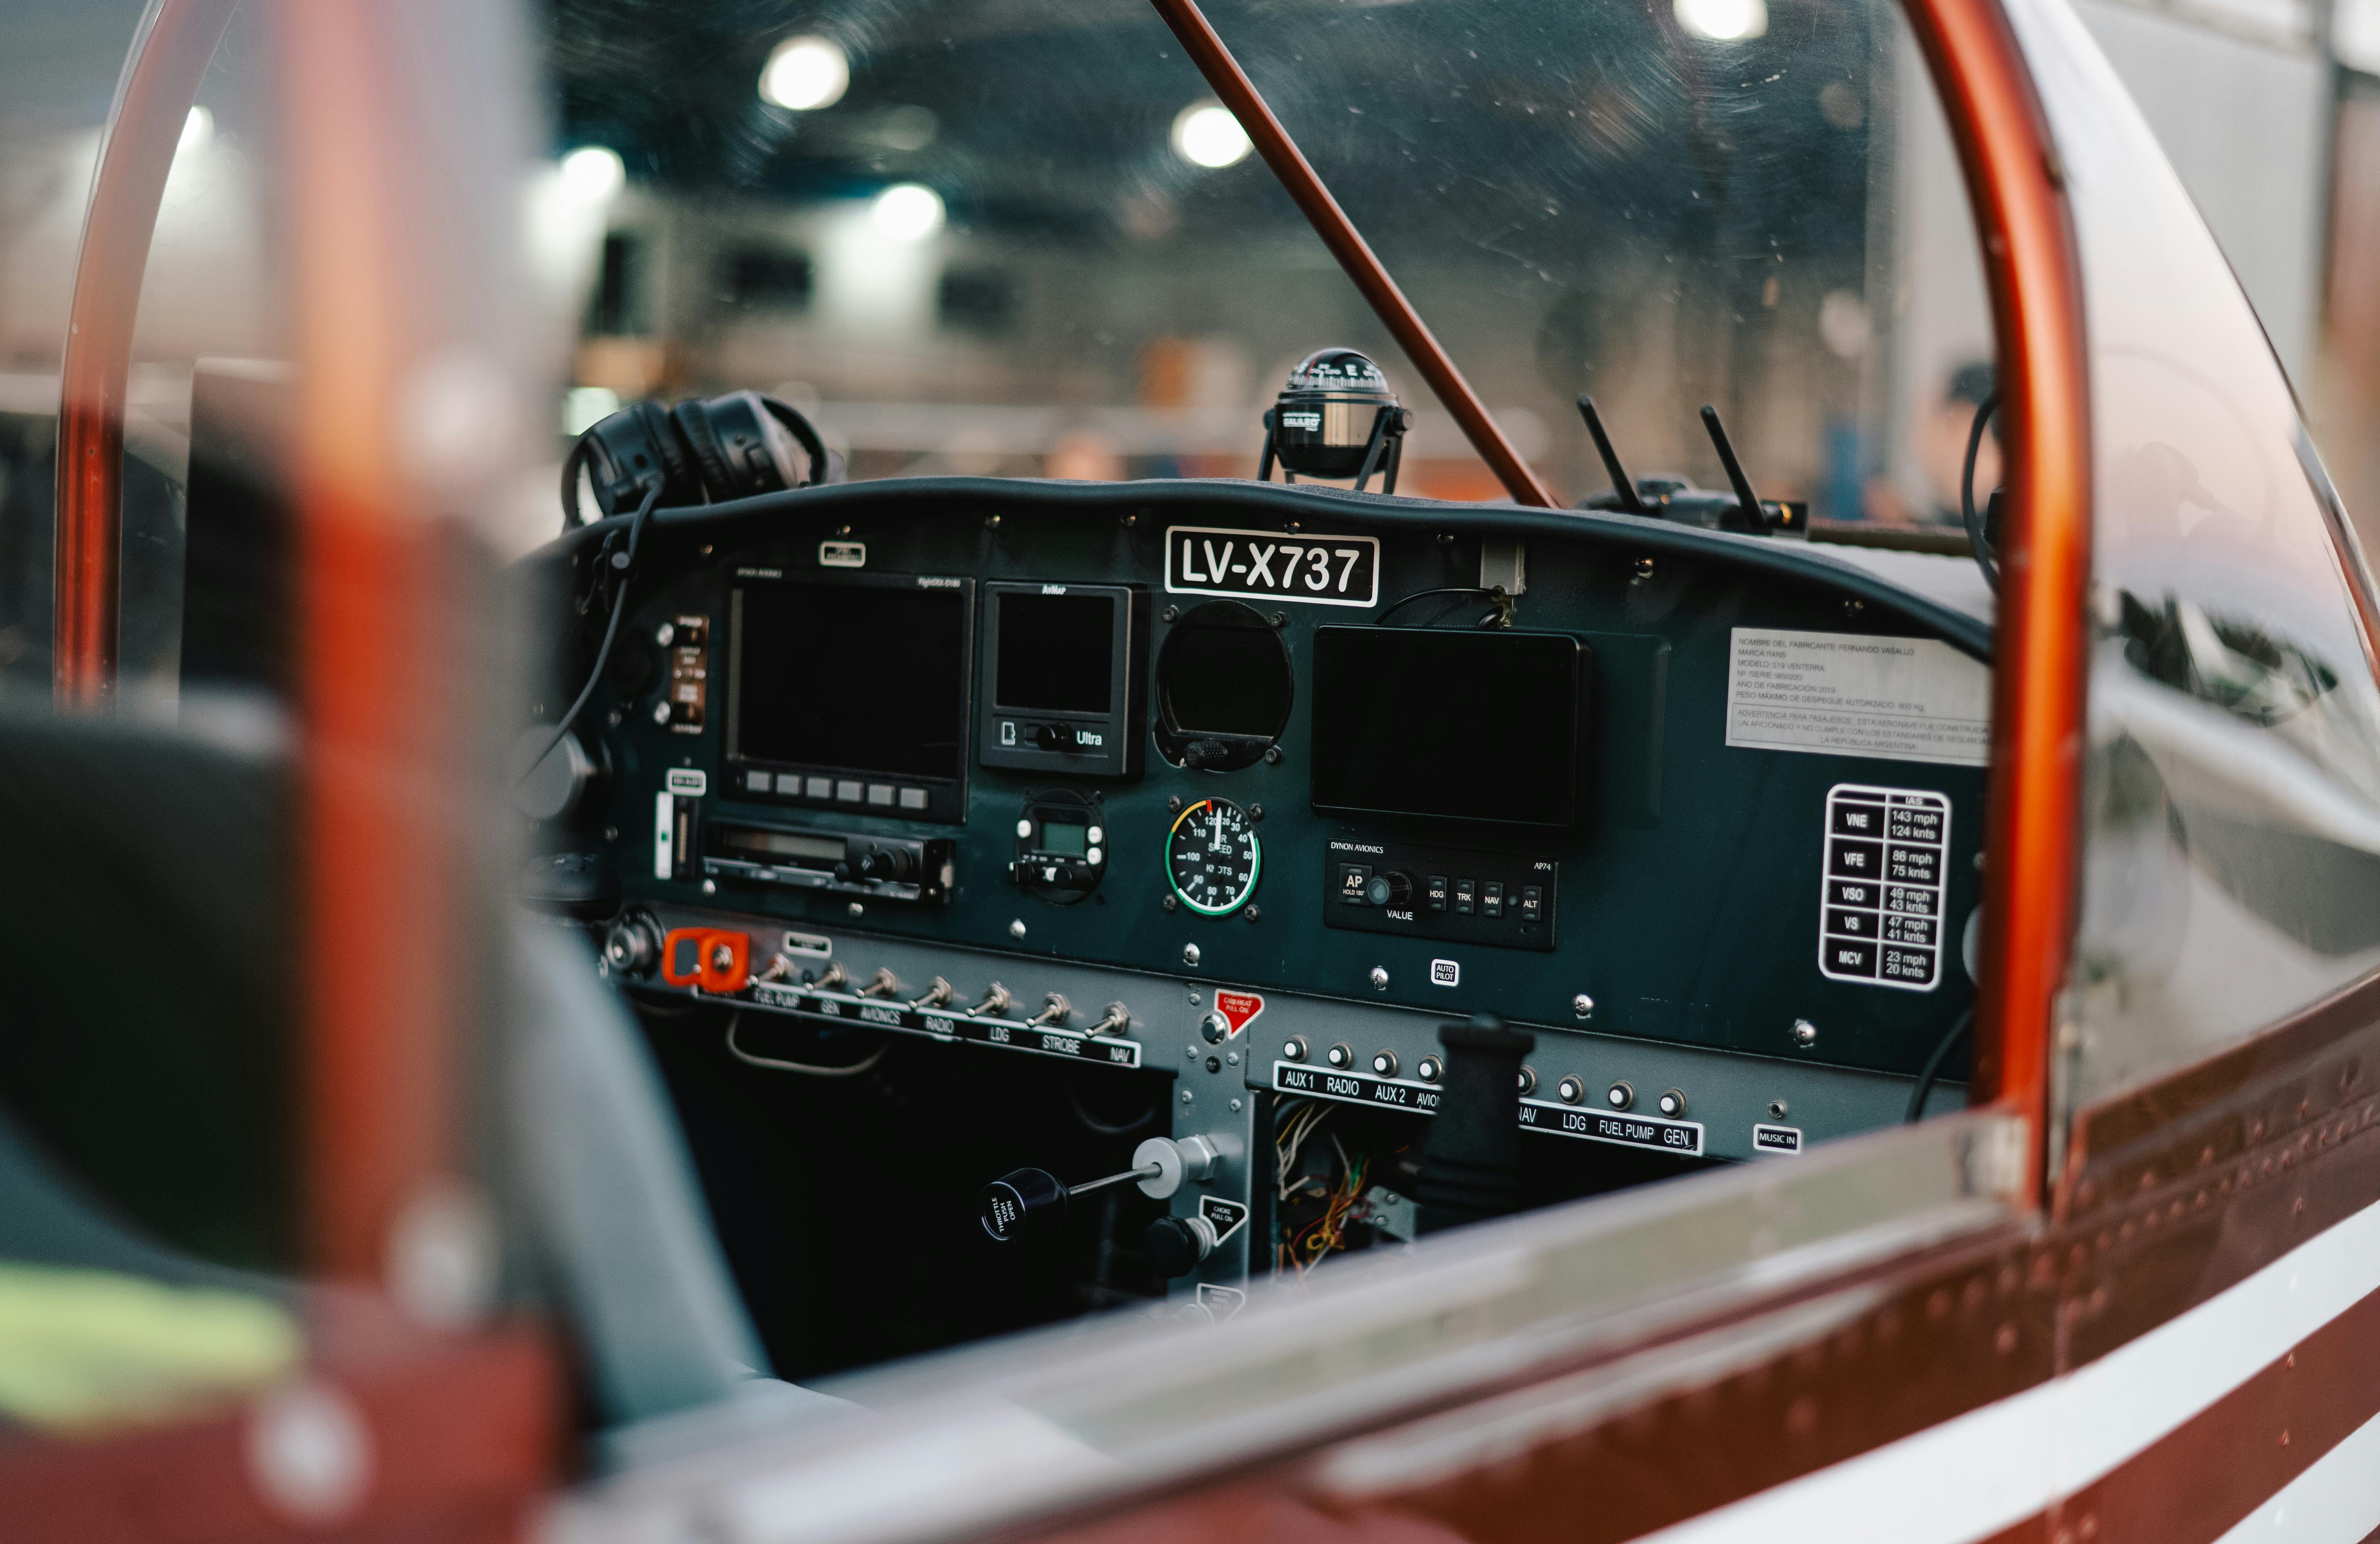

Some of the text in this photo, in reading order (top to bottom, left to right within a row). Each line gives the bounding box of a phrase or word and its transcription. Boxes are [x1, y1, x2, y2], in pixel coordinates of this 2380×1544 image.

[1345, 364, 1358, 376] E
[1183, 539, 1359, 592] LV-X737
[1739, 638, 1770, 647] NOMBRE
[1838, 644, 1879, 653] FERNANDO
[1881, 647, 1914, 655] VASALLO
[1787, 663, 1824, 671] VENTERRA
[1802, 696, 1843, 705] DESPEGUE
[1738, 710, 1786, 719] ADVERTENCIA
[1878, 720, 1918, 729] AERONAVE
[1750, 721, 1793, 730] AFICIONADO
[1076, 731, 1102, 746] Ultra
[1874, 740, 1915, 750] ARGENTINA
[1905, 796, 1923, 805] IAS
[1205, 816, 1217, 825] 120
[1846, 813, 1867, 827] VNE
[1892, 810, 1938, 826] 143 mph
[1193, 828, 1206, 837] 110
[1231, 823, 1240, 831] 30
[1891, 825, 1936, 839] 124 knts
[1238, 834, 1248, 843] 40
[1331, 842, 1383, 854] DYNON AVIONICS
[1186, 852, 1200, 861] 100
[1243, 851, 1252, 860] 50
[1844, 852, 1864, 867] VFE
[1893, 850, 1932, 866] 86 mph
[1534, 862, 1551, 871] AP74
[1892, 865, 1931, 879] 75 knts
[1194, 875, 1204, 884] 90
[1238, 873, 1248, 881] 60
[1346, 875, 1362, 887] AP
[1207, 886, 1217, 895] 80
[1225, 886, 1235, 895] 70
[1457, 893, 1471, 901] TRK
[1890, 887, 1930, 903] 49 mph
[1485, 896, 1499, 904] NAV
[1889, 899, 1929, 914] 43 knts
[1387, 909, 1413, 920] VALUE
[1845, 916, 1858, 930] VS
[1888, 916, 1928, 932] 47 mph
[1887, 928, 1926, 943] 41 knts
[1839, 951, 1862, 965] MCV
[1887, 951, 1926, 967] 23 mph
[1436, 964, 1454, 973] AUTO
[1886, 962, 1925, 978] 20 knts
[1436, 972, 1454, 980] PILOT
[820, 998, 840, 1016] GEN
[860, 1006, 902, 1026] AVIONICS
[925, 1015, 954, 1034] RADIO
[990, 1026, 1010, 1043] LDG
[1043, 1035, 1081, 1055] STROBE
[1110, 1047, 1130, 1063] NAV
[1285, 1071, 1314, 1088] AUX 1
[1327, 1076, 1359, 1096] RADIO
[1375, 1084, 1406, 1103] AUX 2
[1563, 1113, 1586, 1131] LDG
[1599, 1120, 1654, 1140] FUEL PUMP
[1663, 1128, 1690, 1146] GEN
[1759, 1132, 1795, 1144] MUSIC IN
[991, 1196, 1005, 1233] THROTTLE
[1000, 1202, 1009, 1221] PUSH
[1006, 1200, 1015, 1220] OPEN
[1214, 1206, 1231, 1214] CHOKE
